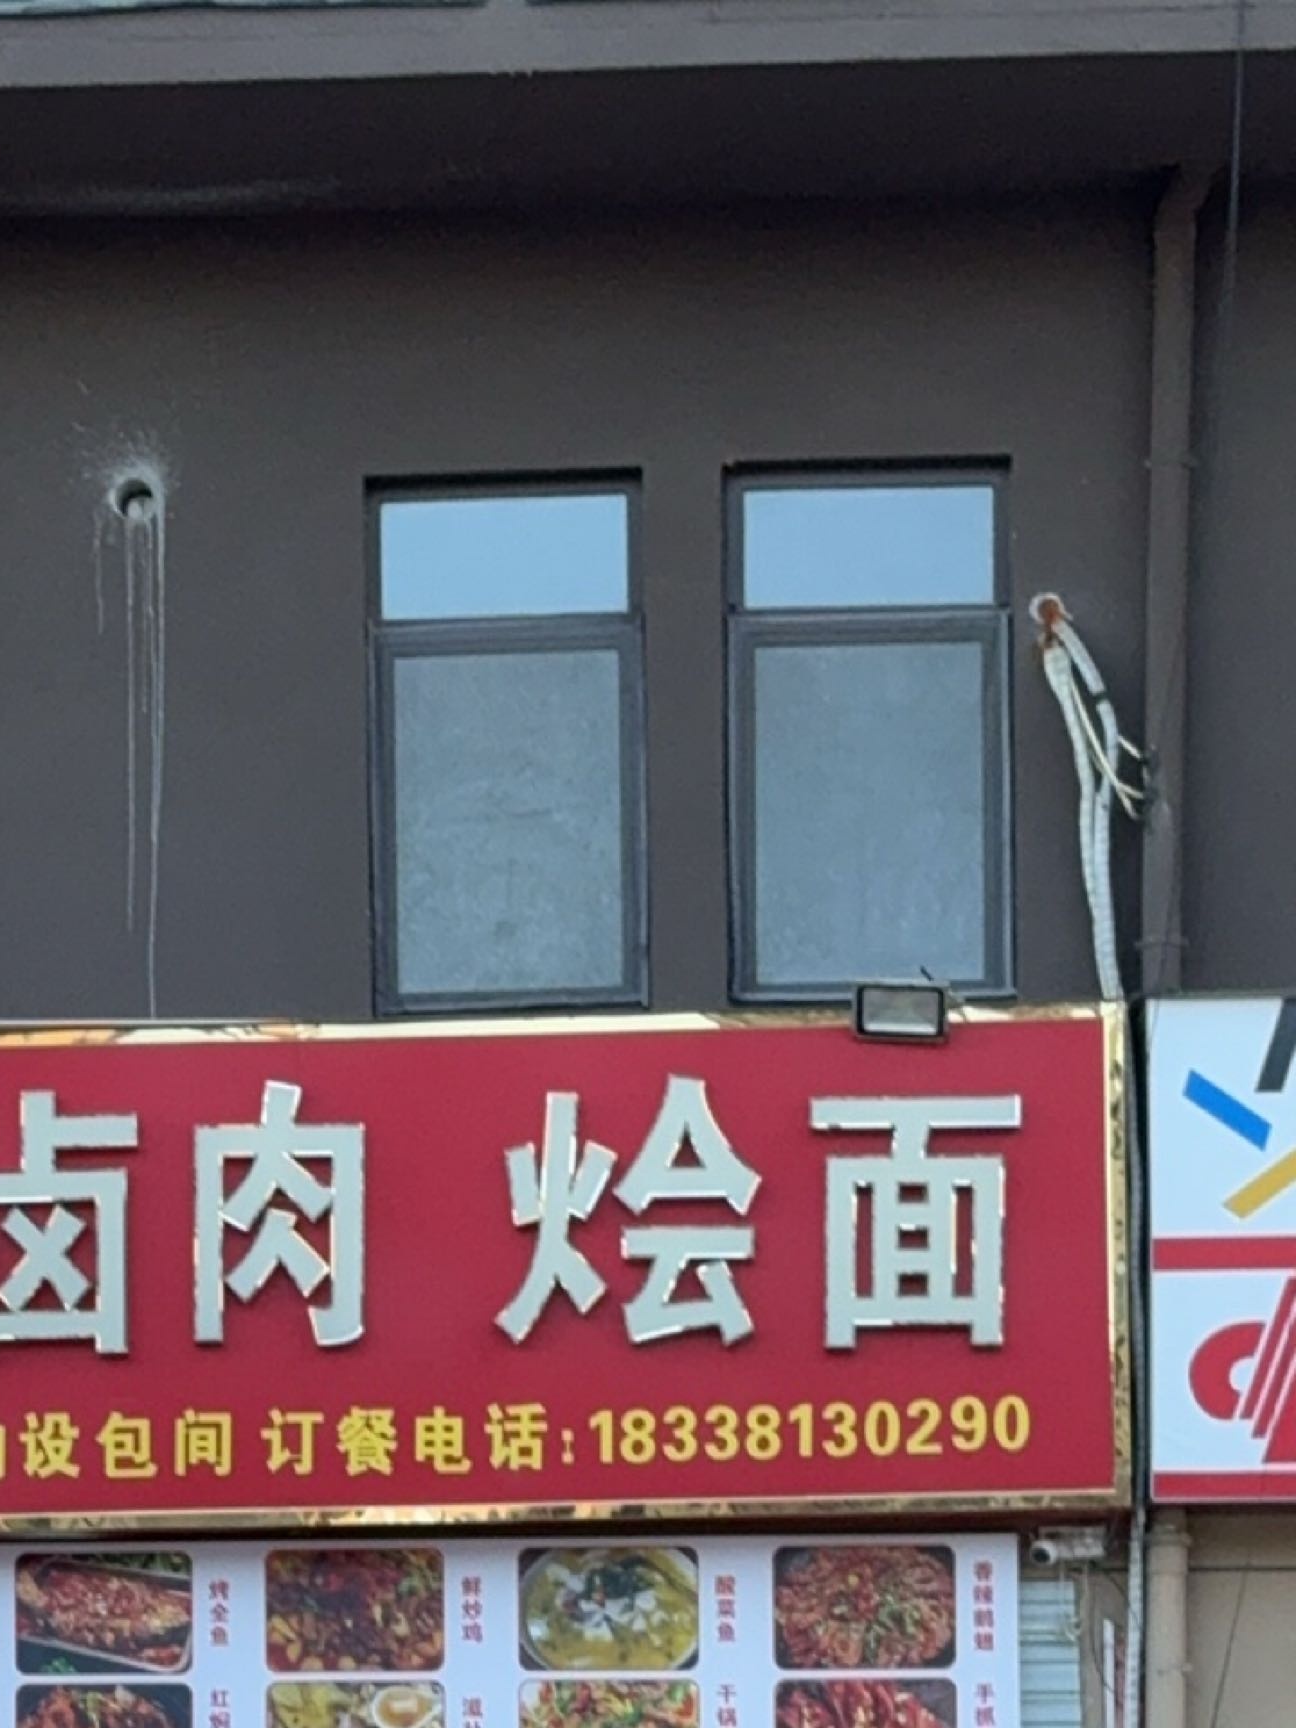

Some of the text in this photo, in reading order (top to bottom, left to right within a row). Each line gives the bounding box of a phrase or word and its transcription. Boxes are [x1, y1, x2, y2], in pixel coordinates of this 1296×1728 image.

[494, 1074, 1024, 1351] 烩面
[208, 1579, 230, 1647] 烤全鱼
[461, 1576, 483, 1643] 鲜炒鸡
[715, 1575, 736, 1643] 酸菜鱼
